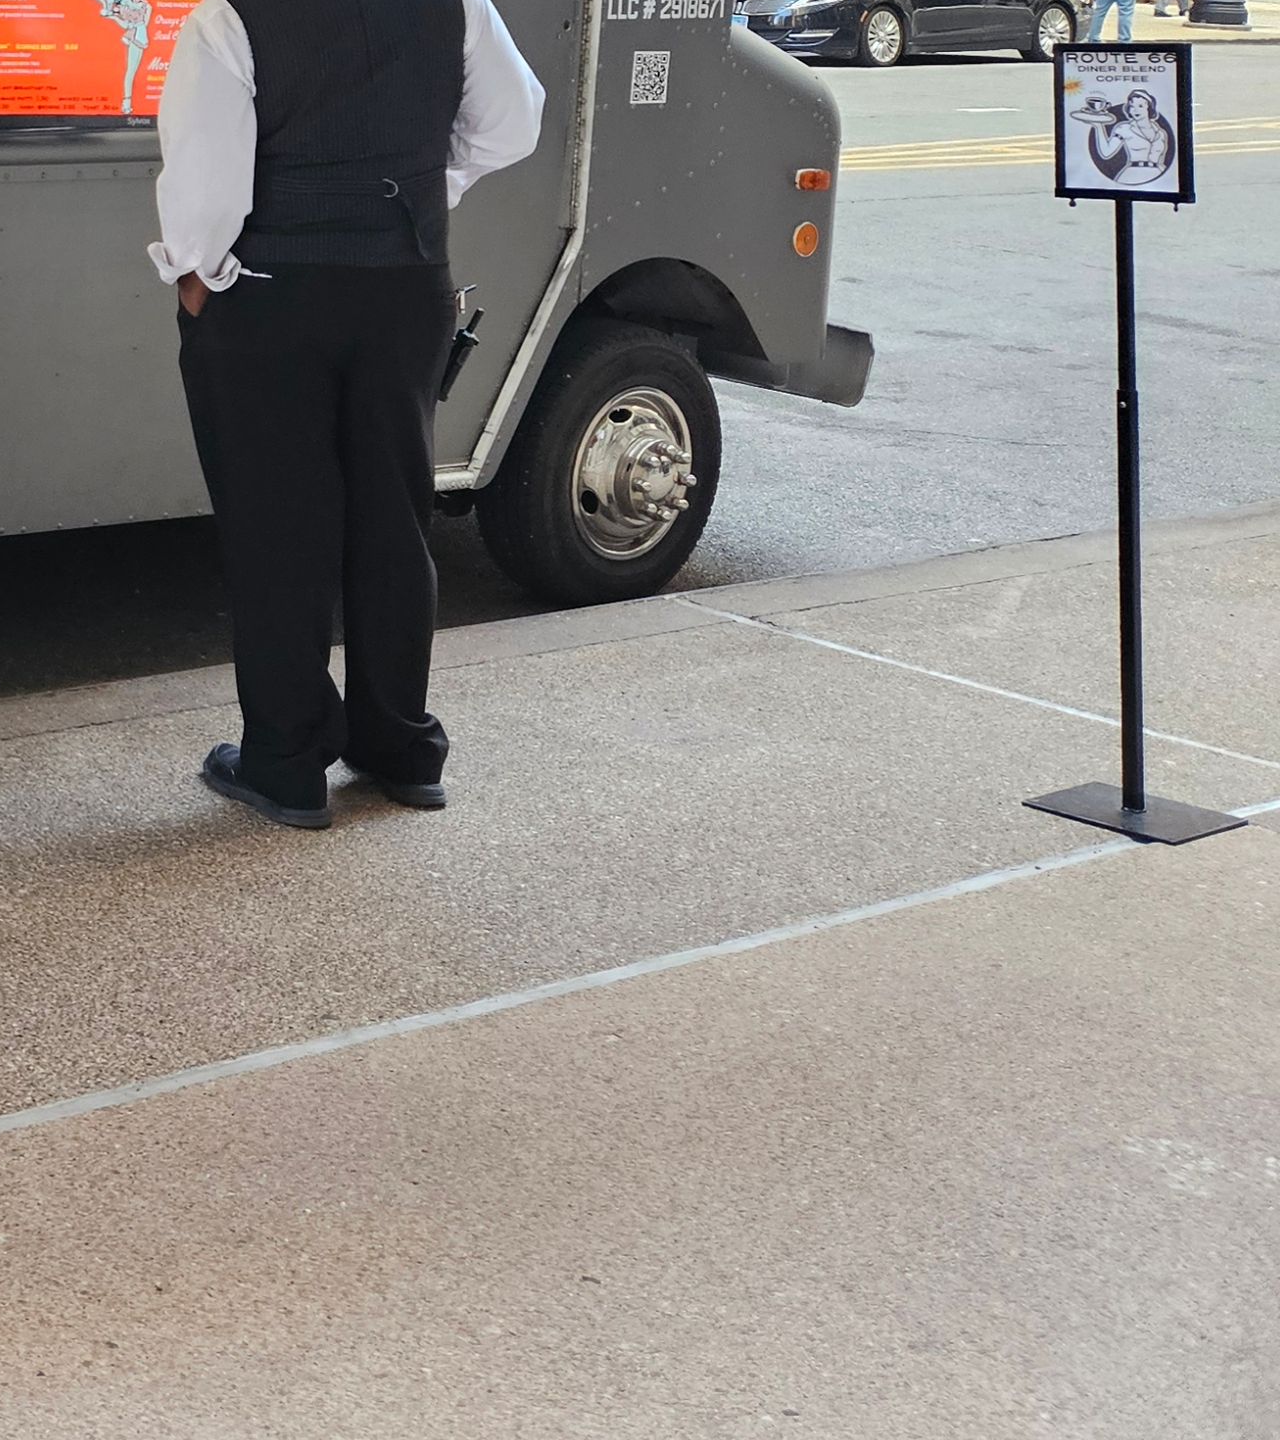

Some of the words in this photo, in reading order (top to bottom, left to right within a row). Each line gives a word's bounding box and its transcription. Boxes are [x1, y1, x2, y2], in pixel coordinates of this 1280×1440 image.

[1066, 52, 1138, 64] ROUTE
[1148, 52, 1177, 64] 66
[1078, 65, 1117, 73] DINER
[1122, 65, 1166, 73] BLEND
[1096, 74, 1149, 83] COFFEE
